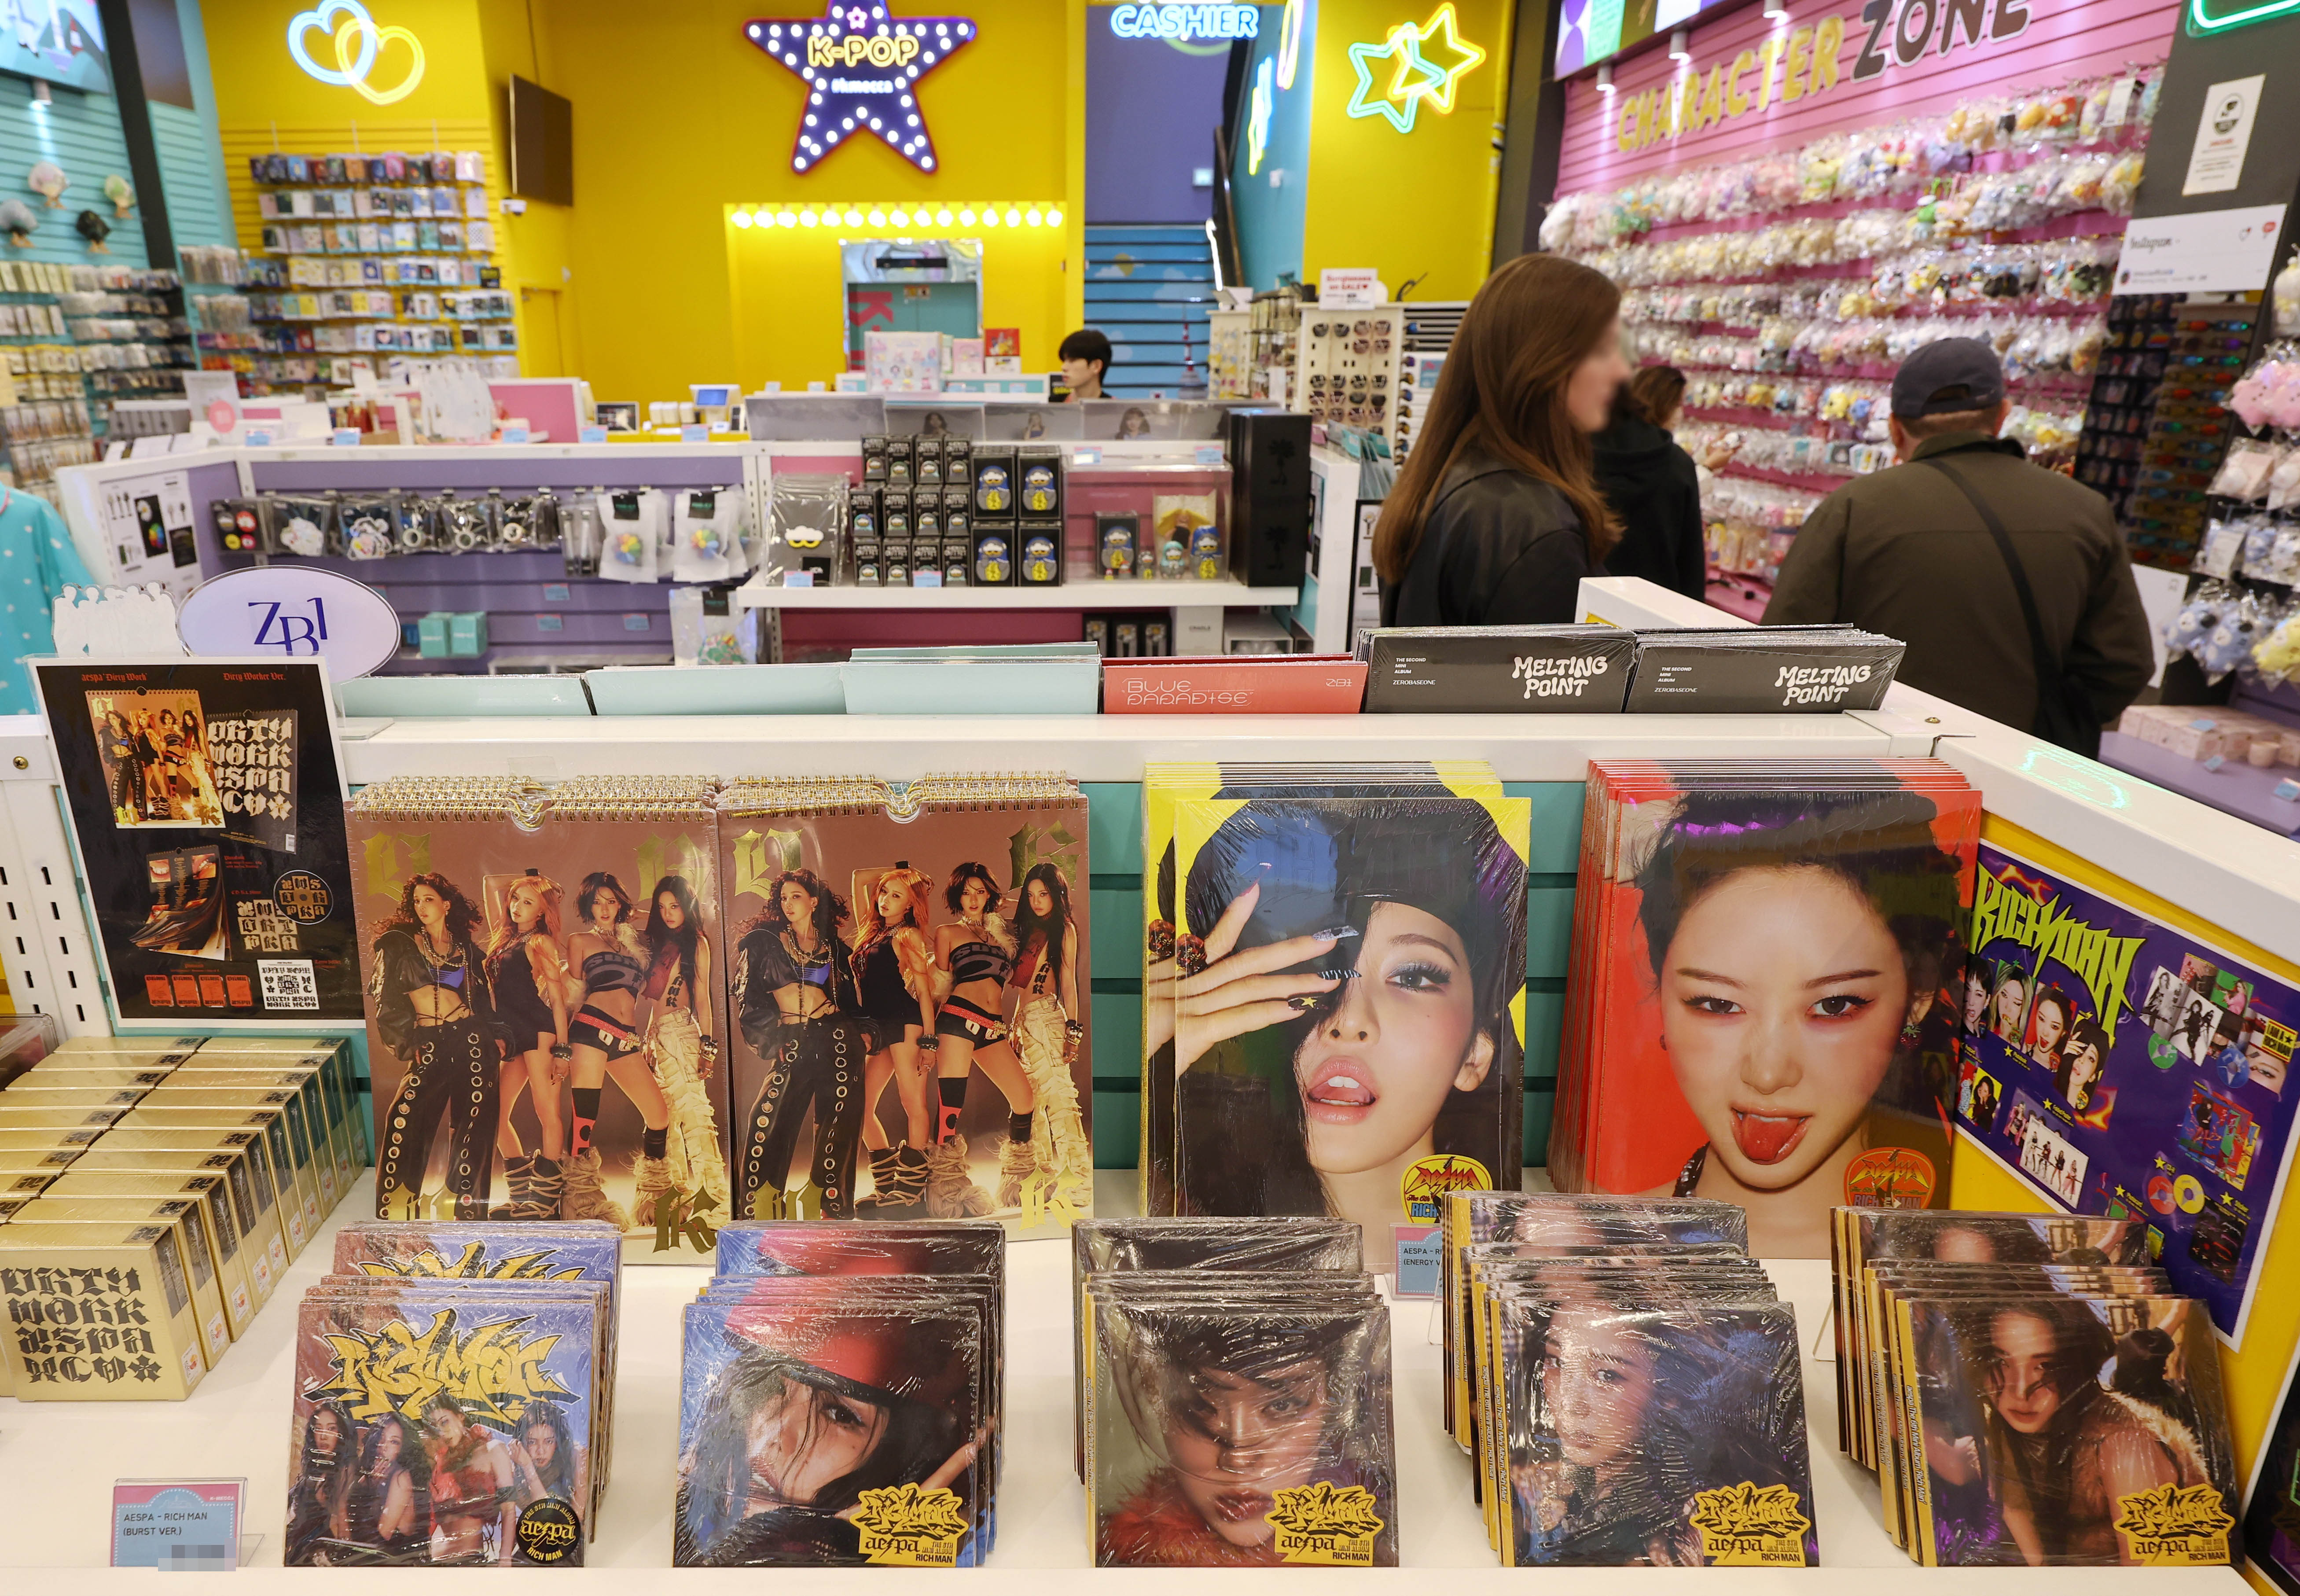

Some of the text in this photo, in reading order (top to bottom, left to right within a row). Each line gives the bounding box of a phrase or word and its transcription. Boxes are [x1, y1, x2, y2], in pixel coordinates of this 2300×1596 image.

[1110, 4, 1260, 38] CASHIER
[807, 35, 919, 67] K-POP
[1617, 0, 2032, 152] CHARACTER ZONE
[2130, 238, 2172, 254] Instagram
[248, 597, 327, 656] ZB1
[1511, 656, 1608, 679] MELTING
[1774, 664, 1872, 688] MELTING
[81, 674, 103, 683] aespa
[223, 672, 286, 682] Dirty Worker Ver.
[1128, 680, 1191, 693] BLUE
[1523, 677, 1589, 699] POINT
[1782, 685, 1849, 706] POINT
[1853, 1194, 1879, 1207] RICH
[1411, 1203, 1438, 1218] RICH
[1906, 1385, 1914, 1406] aespa
[1908, 1406, 1917, 1419] The
[1911, 1431, 1920, 1447] Mini
[1913, 1447, 1922, 1470] Album
[1915, 1469, 1924, 1486] 'Rich
[1917, 1487, 1927, 1505] Man'
[123, 1513, 154, 1522] AESPA
[164, 1512, 185, 1521] RICH
[187, 1512, 208, 1521] MAN
[123, 1526, 182, 1537] (BURST VER.)
[519, 1519, 576, 1548] aespa
[526, 1546, 563, 1561] RICH MAN
[865, 1537, 920, 1559] aespa
[1281, 1535, 1337, 1557] aespa
[1708, 1537, 1765, 1560] aespa
[2135, 1540, 2190, 1563] aespa
[915, 1554, 952, 1563] RICH MAN
[1332, 1552, 1370, 1561] RICH MAN
[1781, 1553, 1800, 1562] MAN
[2189, 1552, 2226, 1561] RICH MAN
